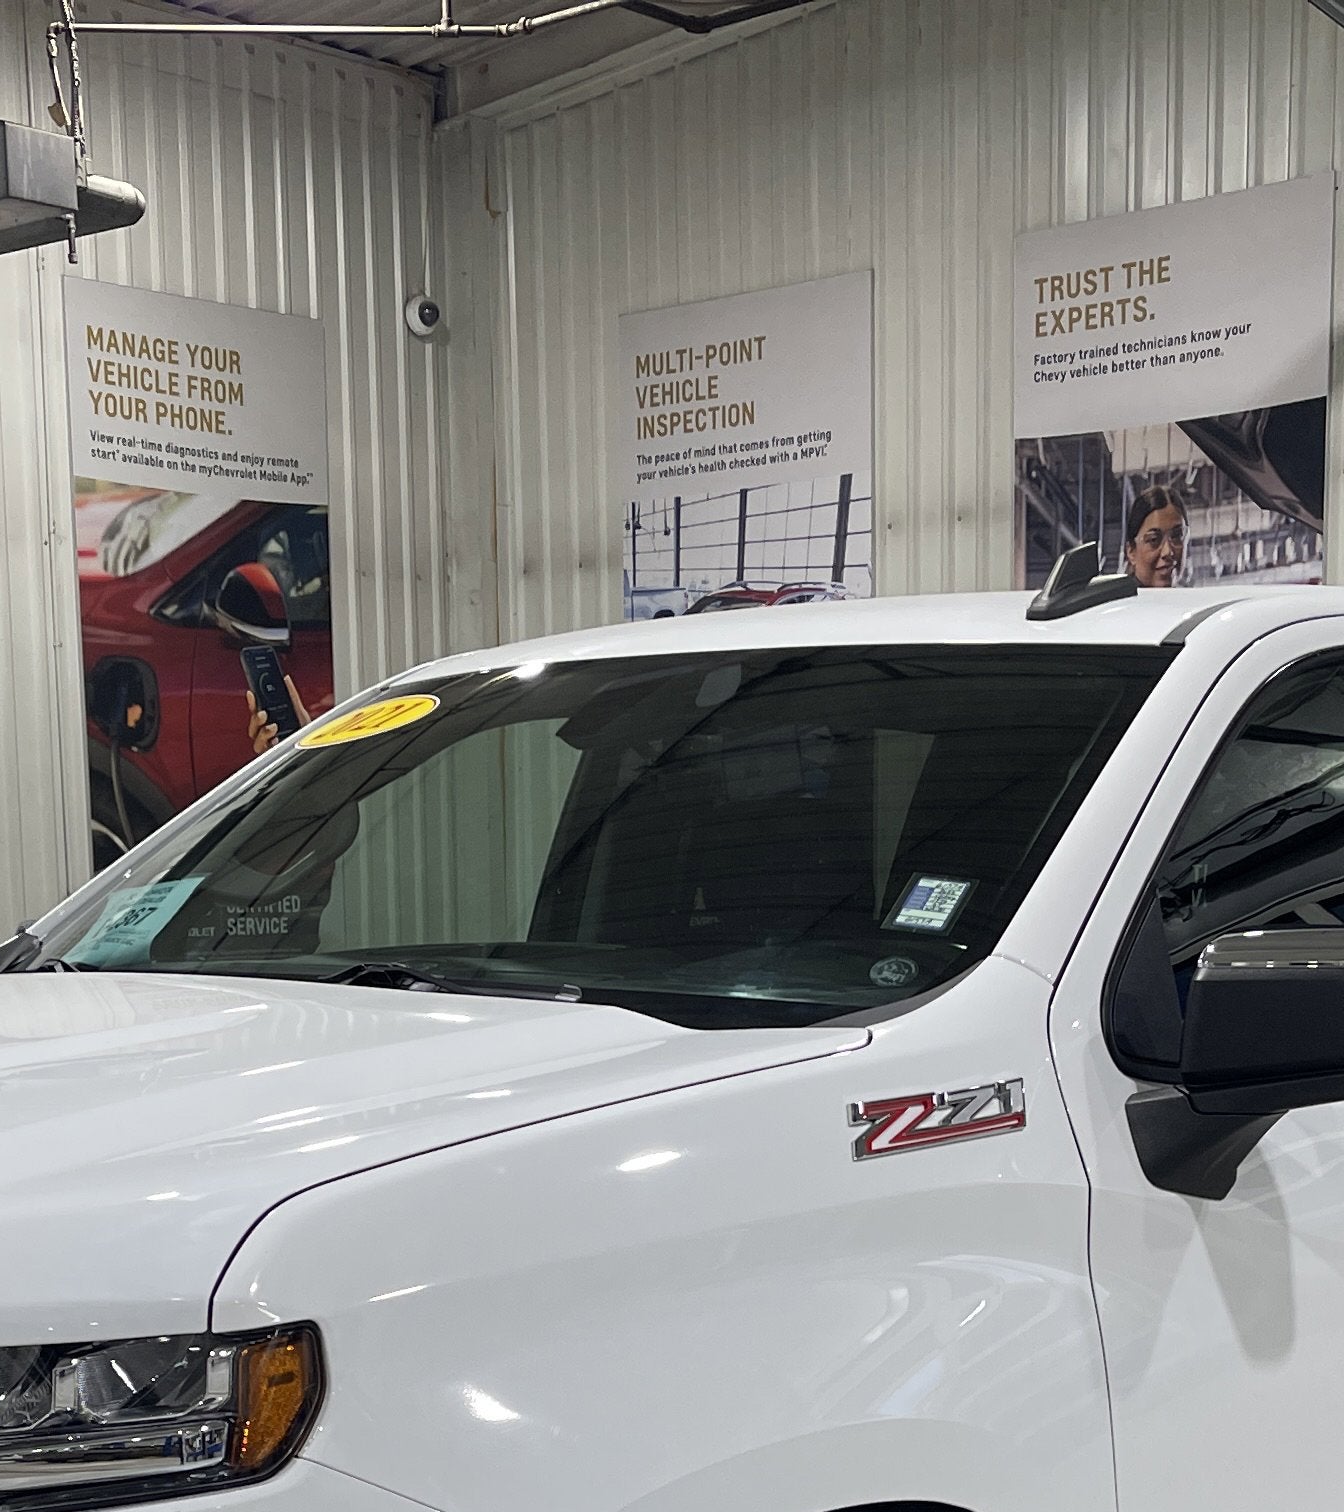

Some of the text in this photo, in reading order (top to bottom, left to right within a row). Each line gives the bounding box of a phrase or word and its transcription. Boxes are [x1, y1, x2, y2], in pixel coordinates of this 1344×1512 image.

[1034, 255, 1171, 304] TRUST THE
[1035, 295, 1156, 338] EXPERTS.
[86, 325, 242, 375] MANAGE YOUR
[635, 335, 766, 379] MULTI-POINT
[1034, 323, 1252, 366] Factory trained technicians know your
[87, 357, 244, 407] VEHICLE FROM
[1034, 370, 1067, 383] Chevy
[1070, 363, 1108, 379] vehicle
[1111, 358, 1147, 373] better
[1150, 353, 1176, 367] than
[635, 374, 719, 409] VEHICLE
[88, 389, 233, 436] YOUR PHONE.
[636, 400, 755, 440] INSPECTION
[90, 430, 299, 469] View real-time diagnostics and enjoy remote
[121, 452, 164, 468] available
[167, 460, 178, 470] on
[181, 461, 196, 473] the
[198, 464, 257, 482] myChevrolet
[259, 470, 288, 483] Mobile
[636, 430, 832, 467] The peace of mind that comes from getting
[636, 471, 657, 484] your
[658, 464, 696, 479] vehicle's
[698, 459, 727, 473] health
[728, 454, 767, 469] checked
[769, 450, 790, 464] with
[227, 918, 288, 936] SERVICE
[846, 1077, 1027, 1162] Z71
